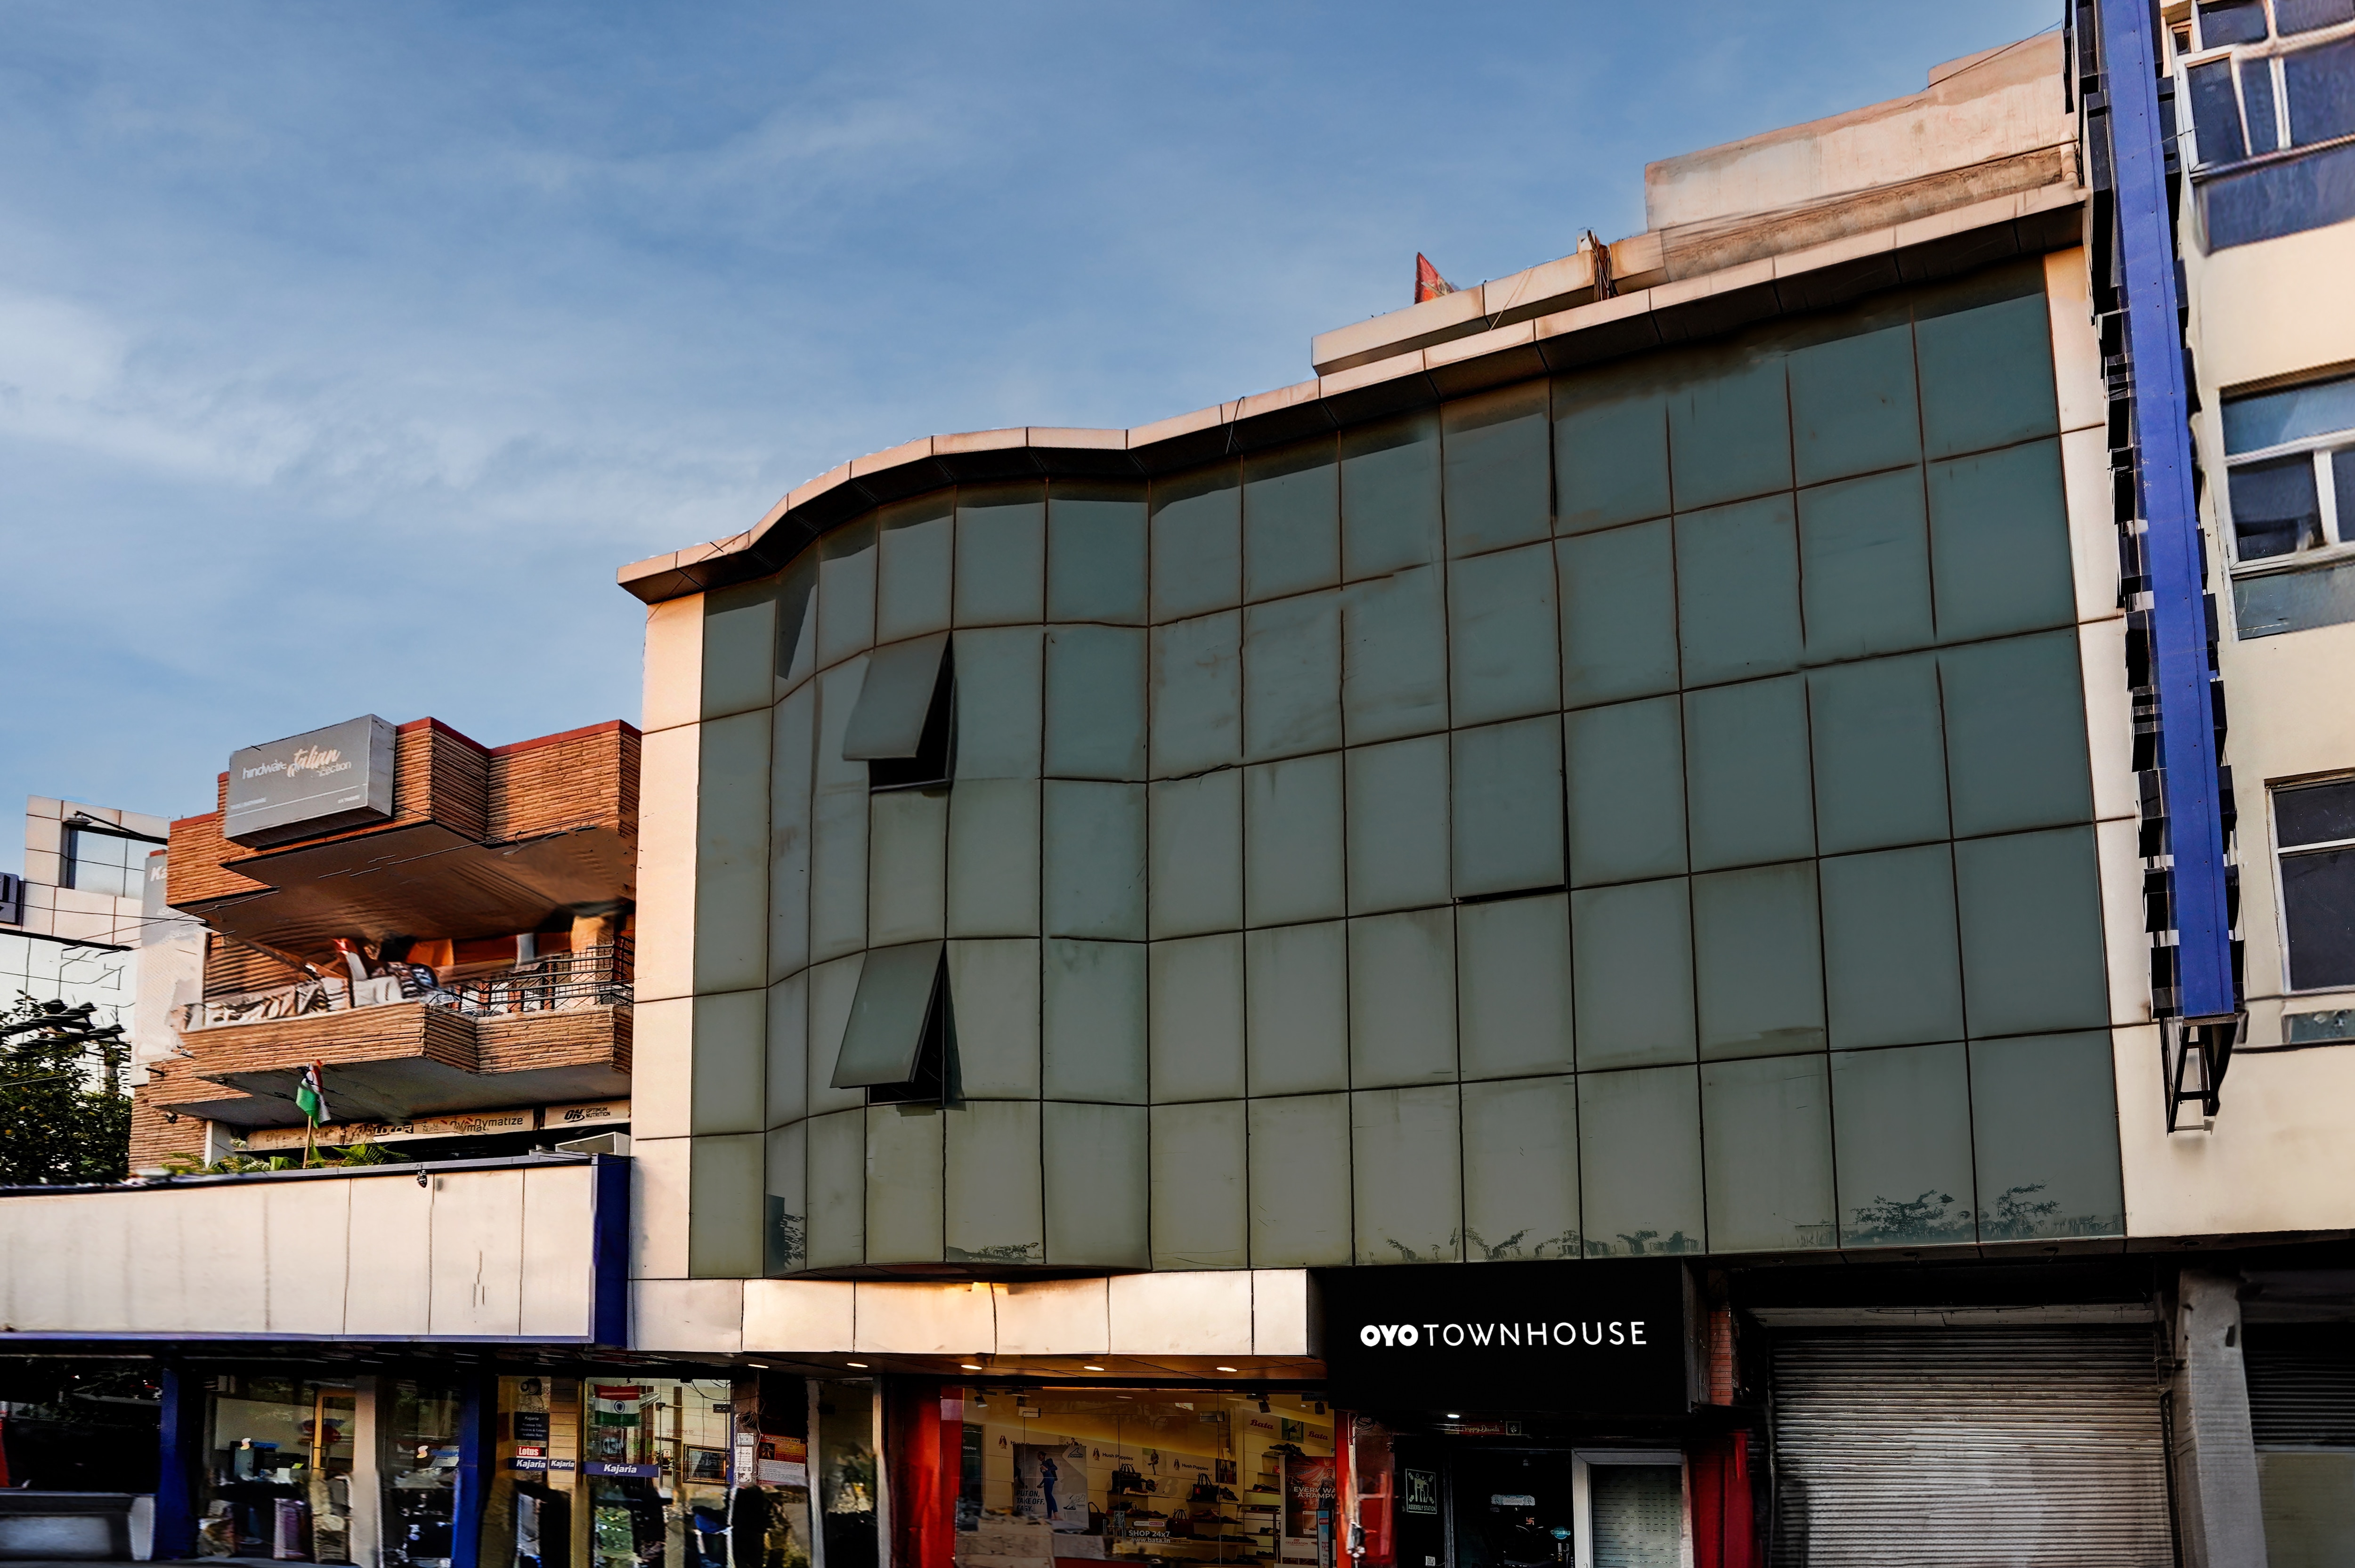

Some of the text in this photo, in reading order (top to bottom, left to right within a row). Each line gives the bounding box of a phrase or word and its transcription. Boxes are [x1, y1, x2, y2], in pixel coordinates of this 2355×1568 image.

[564, 1109, 585, 1121] ON
[1360, 1321, 1647, 1347] OYO TOWNHOUSE
[1250, 1419, 1274, 1430] Bata
[1307, 1431, 1329, 1440] Bata
[518, 1447, 539, 1456] Lotus
[516, 1459, 546, 1469] Kajaria
[603, 1464, 637, 1474] Kajaria
